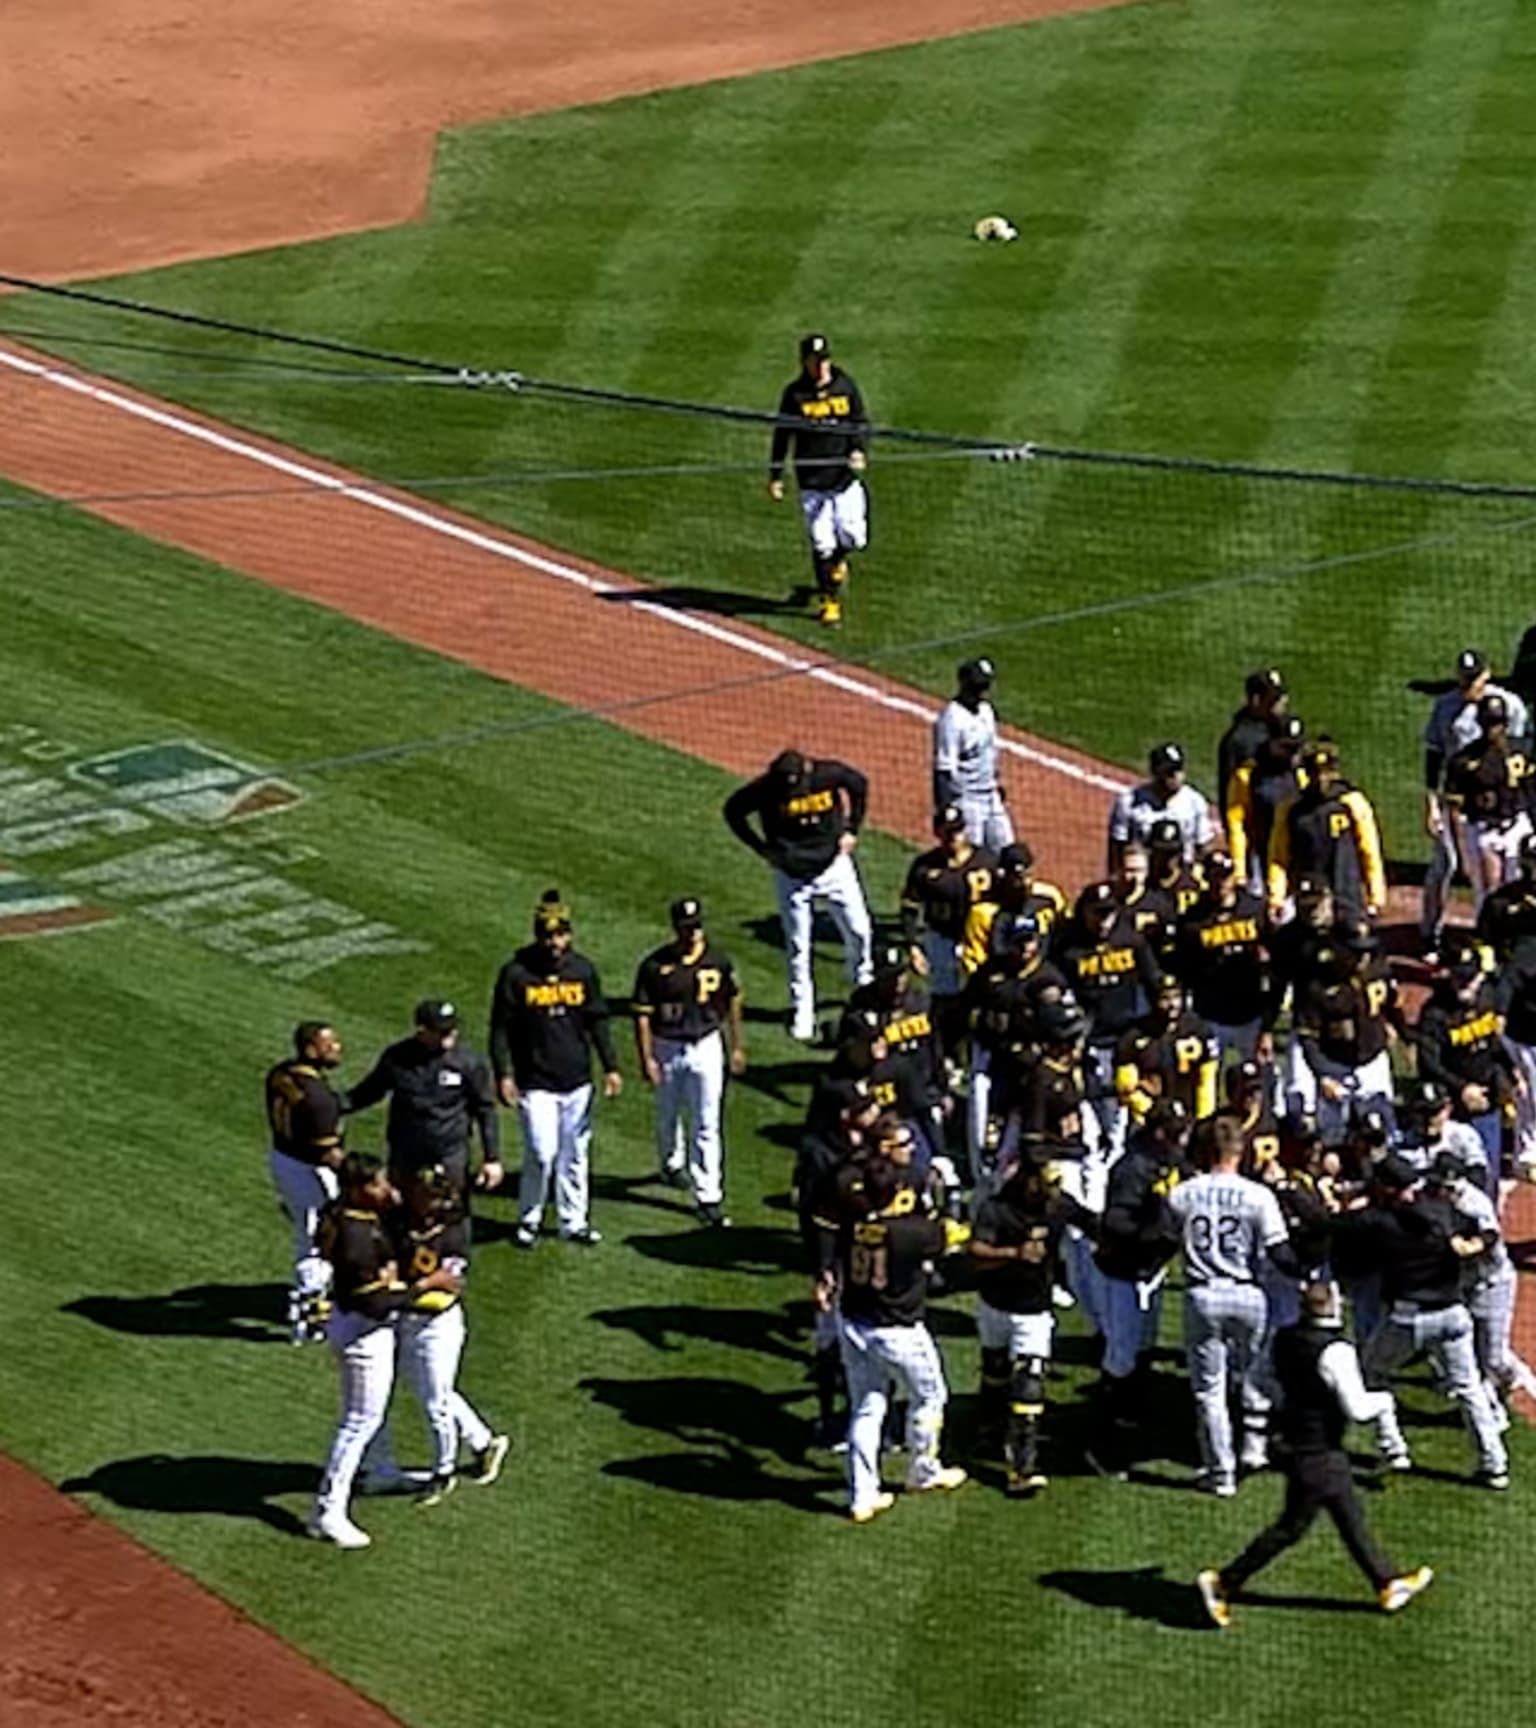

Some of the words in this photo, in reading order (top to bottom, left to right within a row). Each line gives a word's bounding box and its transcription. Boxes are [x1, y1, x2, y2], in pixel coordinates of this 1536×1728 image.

[696, 968, 722, 1004] P
[1366, 979, 1388, 1017] P
[1175, 1036, 1202, 1073] P
[1191, 1215, 1241, 1253] 32
